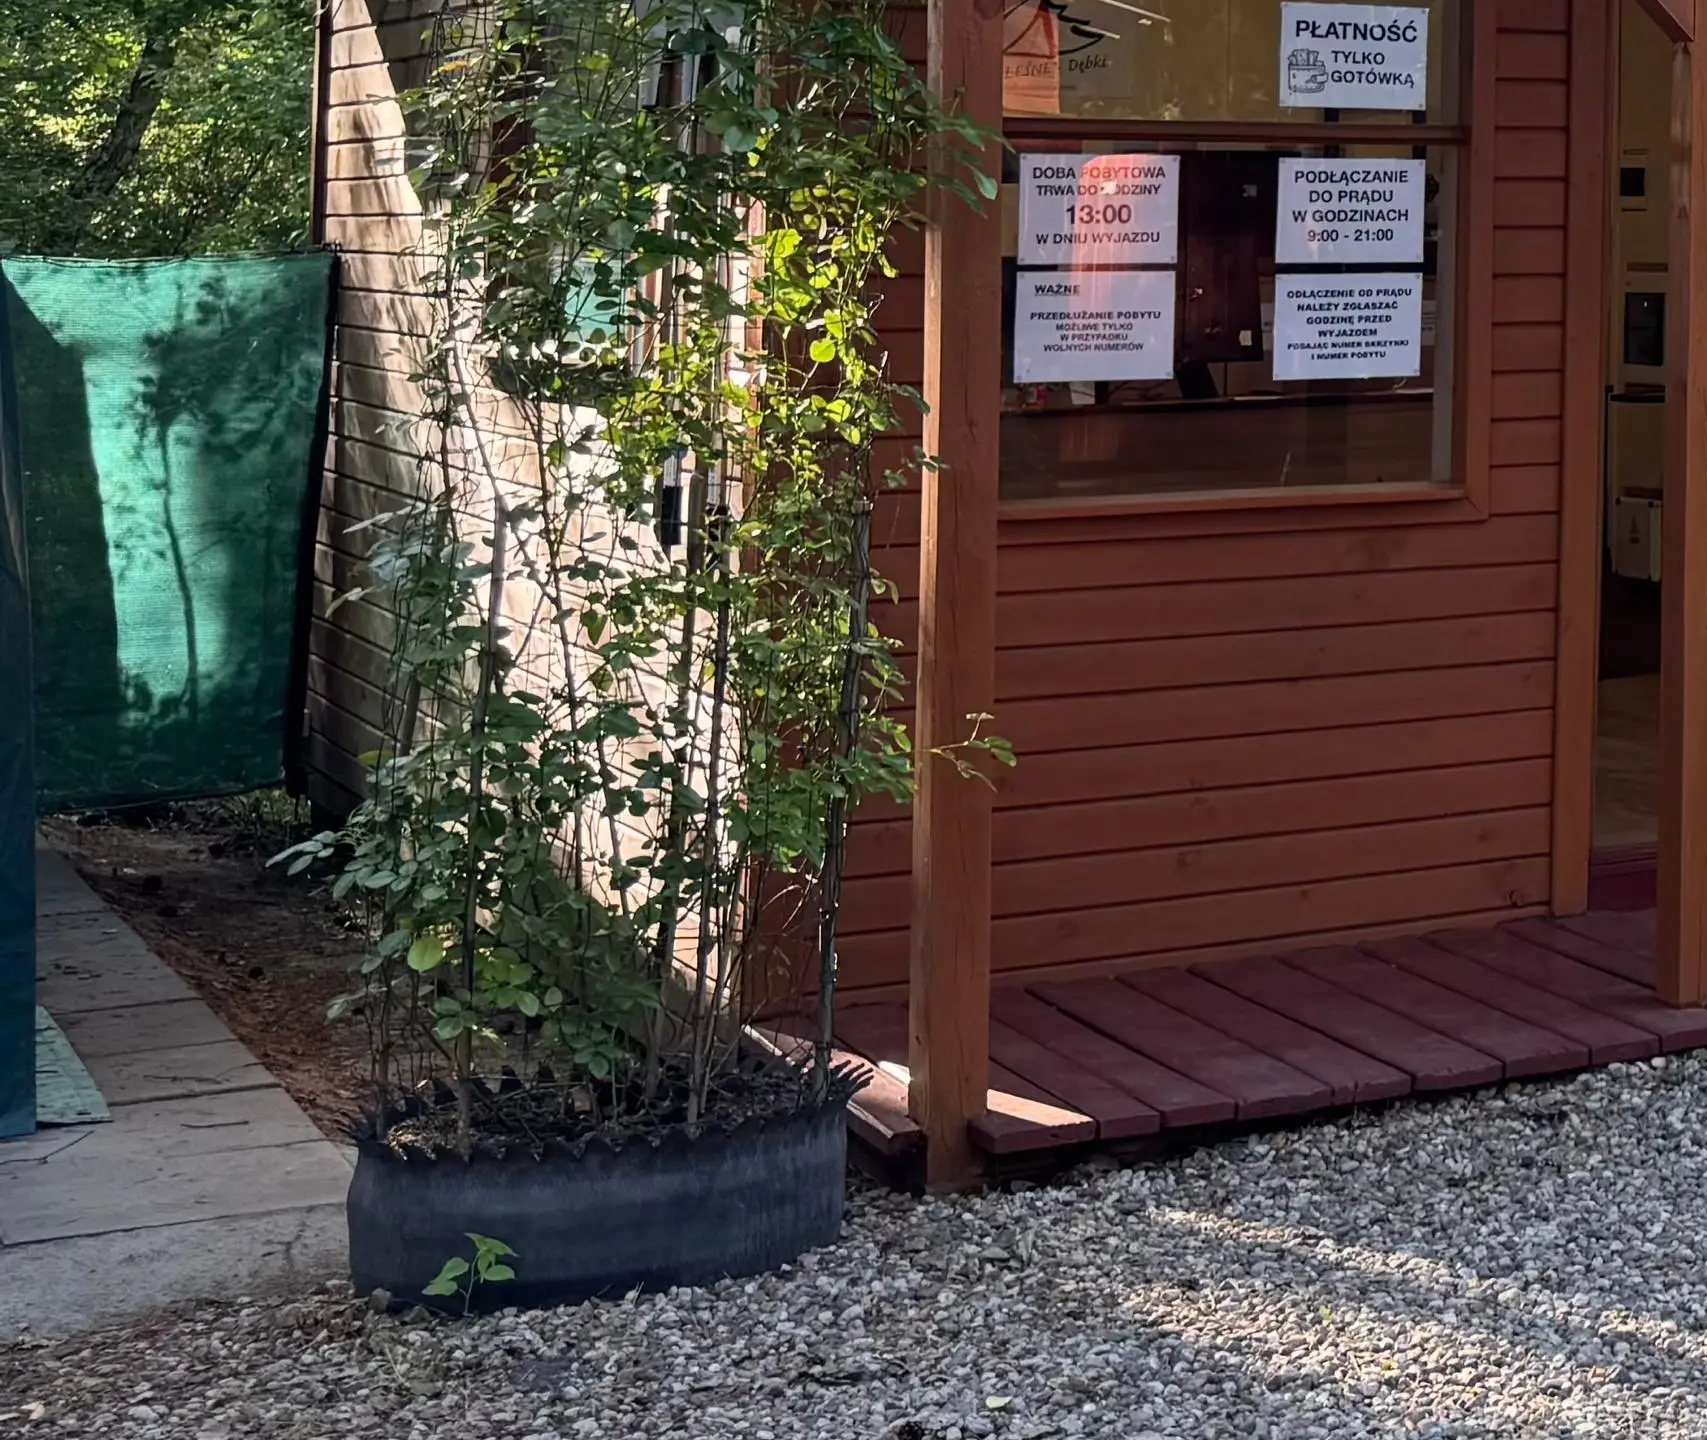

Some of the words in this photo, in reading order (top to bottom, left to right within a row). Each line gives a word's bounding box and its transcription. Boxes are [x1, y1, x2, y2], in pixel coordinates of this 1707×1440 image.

[1295, 19, 1418, 43] PŁATNOŚĆ
[1331, 50, 1385, 65] TYLKO
[1330, 68, 1415, 89] GOTÓWKĄ
[1032, 166, 1076, 179] DOBA
[1080, 166, 1166, 179] POBYTOWA
[1294, 170, 1409, 186] PODŁĄCZANIE
[1036, 185, 1075, 196] TRWA
[1077, 185, 1098, 196] DO
[1309, 190, 1333, 203] DO
[1338, 190, 1394, 205] PRĄDU
[1065, 204, 1132, 224] 13:00
[1292, 210, 1308, 223] W
[1312, 209, 1409, 222] GODZINACH
[1036, 233, 1049, 244] W
[1053, 233, 1088, 244] DNIU
[1092, 232, 1160, 244] WYJAZDU
[1307, 229, 1339, 241] 9:00
[1354, 229, 1394, 241] 21:00
[1034, 283, 1081, 295] WAŻNE
[1286, 289, 1355, 299] ODŁĄCZENIE
[1358, 288, 1374, 298] OD
[1376, 288, 1412, 299] PRĄDU
[1297, 302, 1340, 312] NALEŻY
[1342, 301, 1398, 311] ZGŁASZAĆ
[1030, 311, 1114, 321] PRZEDŁUŻANIE
[1117, 311, 1162, 320] POBYTU
[1306, 316, 1355, 326] GODZINĘ
[1357, 314, 1392, 324] PRZED
[1101, 322, 1133, 331] TYLKO
[1060, 333, 1069, 341] W
[1318, 328, 1378, 338] WYJAZDEM
[1043, 343, 1092, 352] WOLNYCH
[1331, 341, 1362, 349] NUMER
[1317, 352, 1348, 360] NUMER
